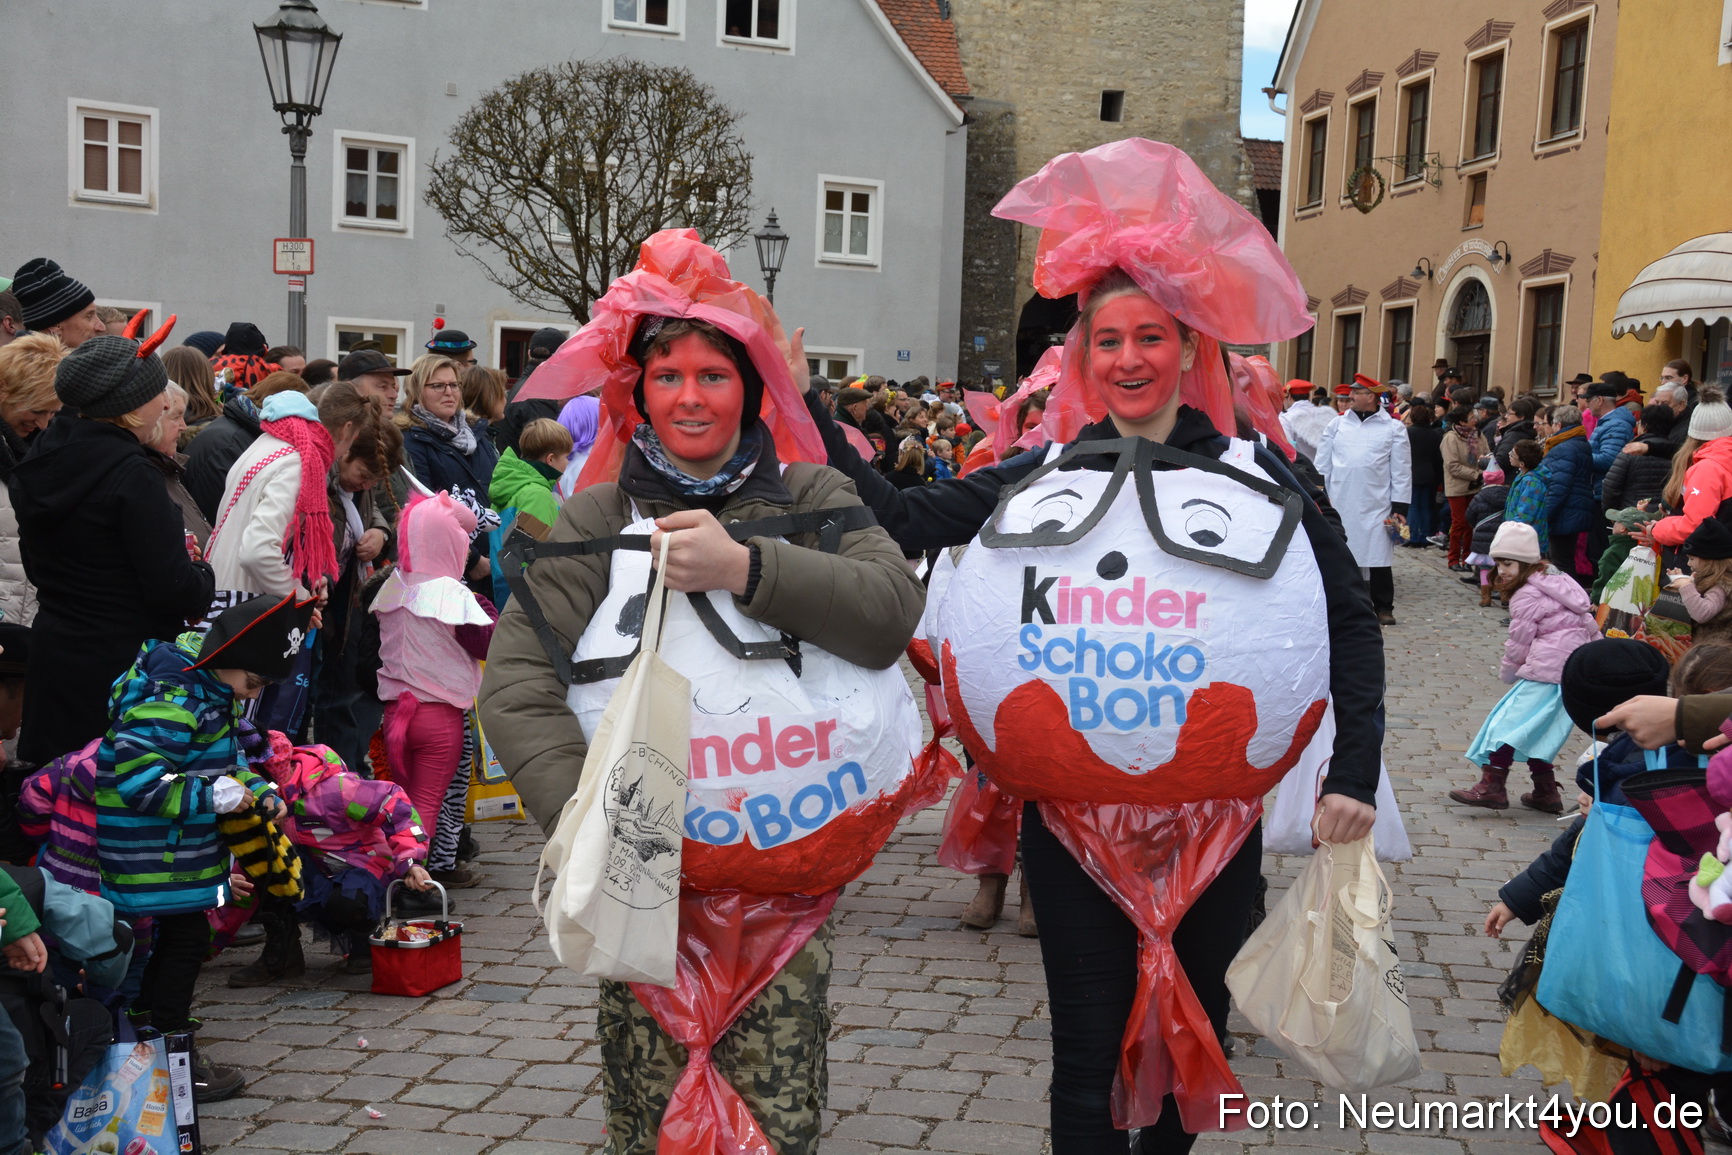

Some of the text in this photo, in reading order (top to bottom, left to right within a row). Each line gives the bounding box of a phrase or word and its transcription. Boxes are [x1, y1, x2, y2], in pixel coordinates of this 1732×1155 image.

[283, 242, 304, 250] H300
[1018, 624, 1206, 683] Schoko
[1068, 676, 1187, 731] Bon
[688, 716, 837, 779] nder
[744, 761, 867, 848] Bon
[74, 1100, 108, 1119] Baea
